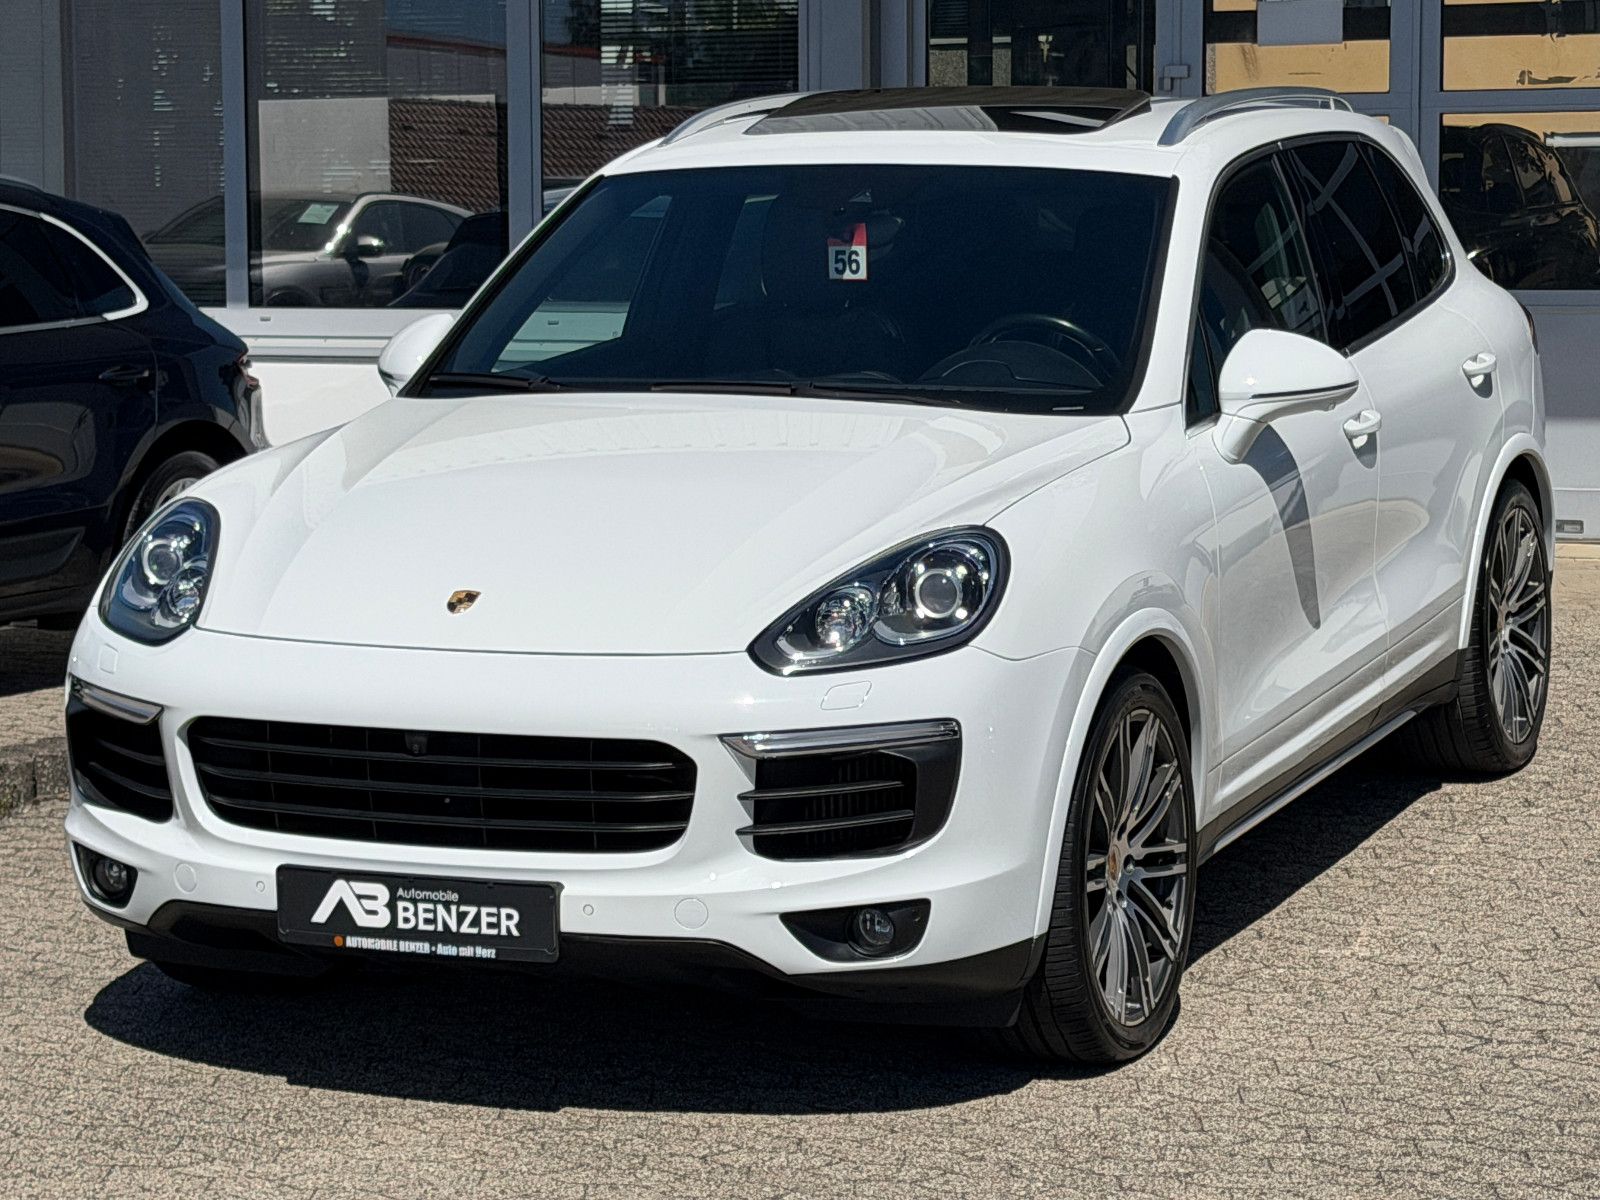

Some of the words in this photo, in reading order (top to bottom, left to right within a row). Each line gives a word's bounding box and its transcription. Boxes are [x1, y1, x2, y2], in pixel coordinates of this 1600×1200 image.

[834, 249, 861, 275] 56
[310, 879, 392, 929] AB
[396, 887, 460, 902] Automobile
[396, 901, 521, 937] BENZER
[436, 943, 458, 956] Auto
[458, 945, 474, 957] mit
